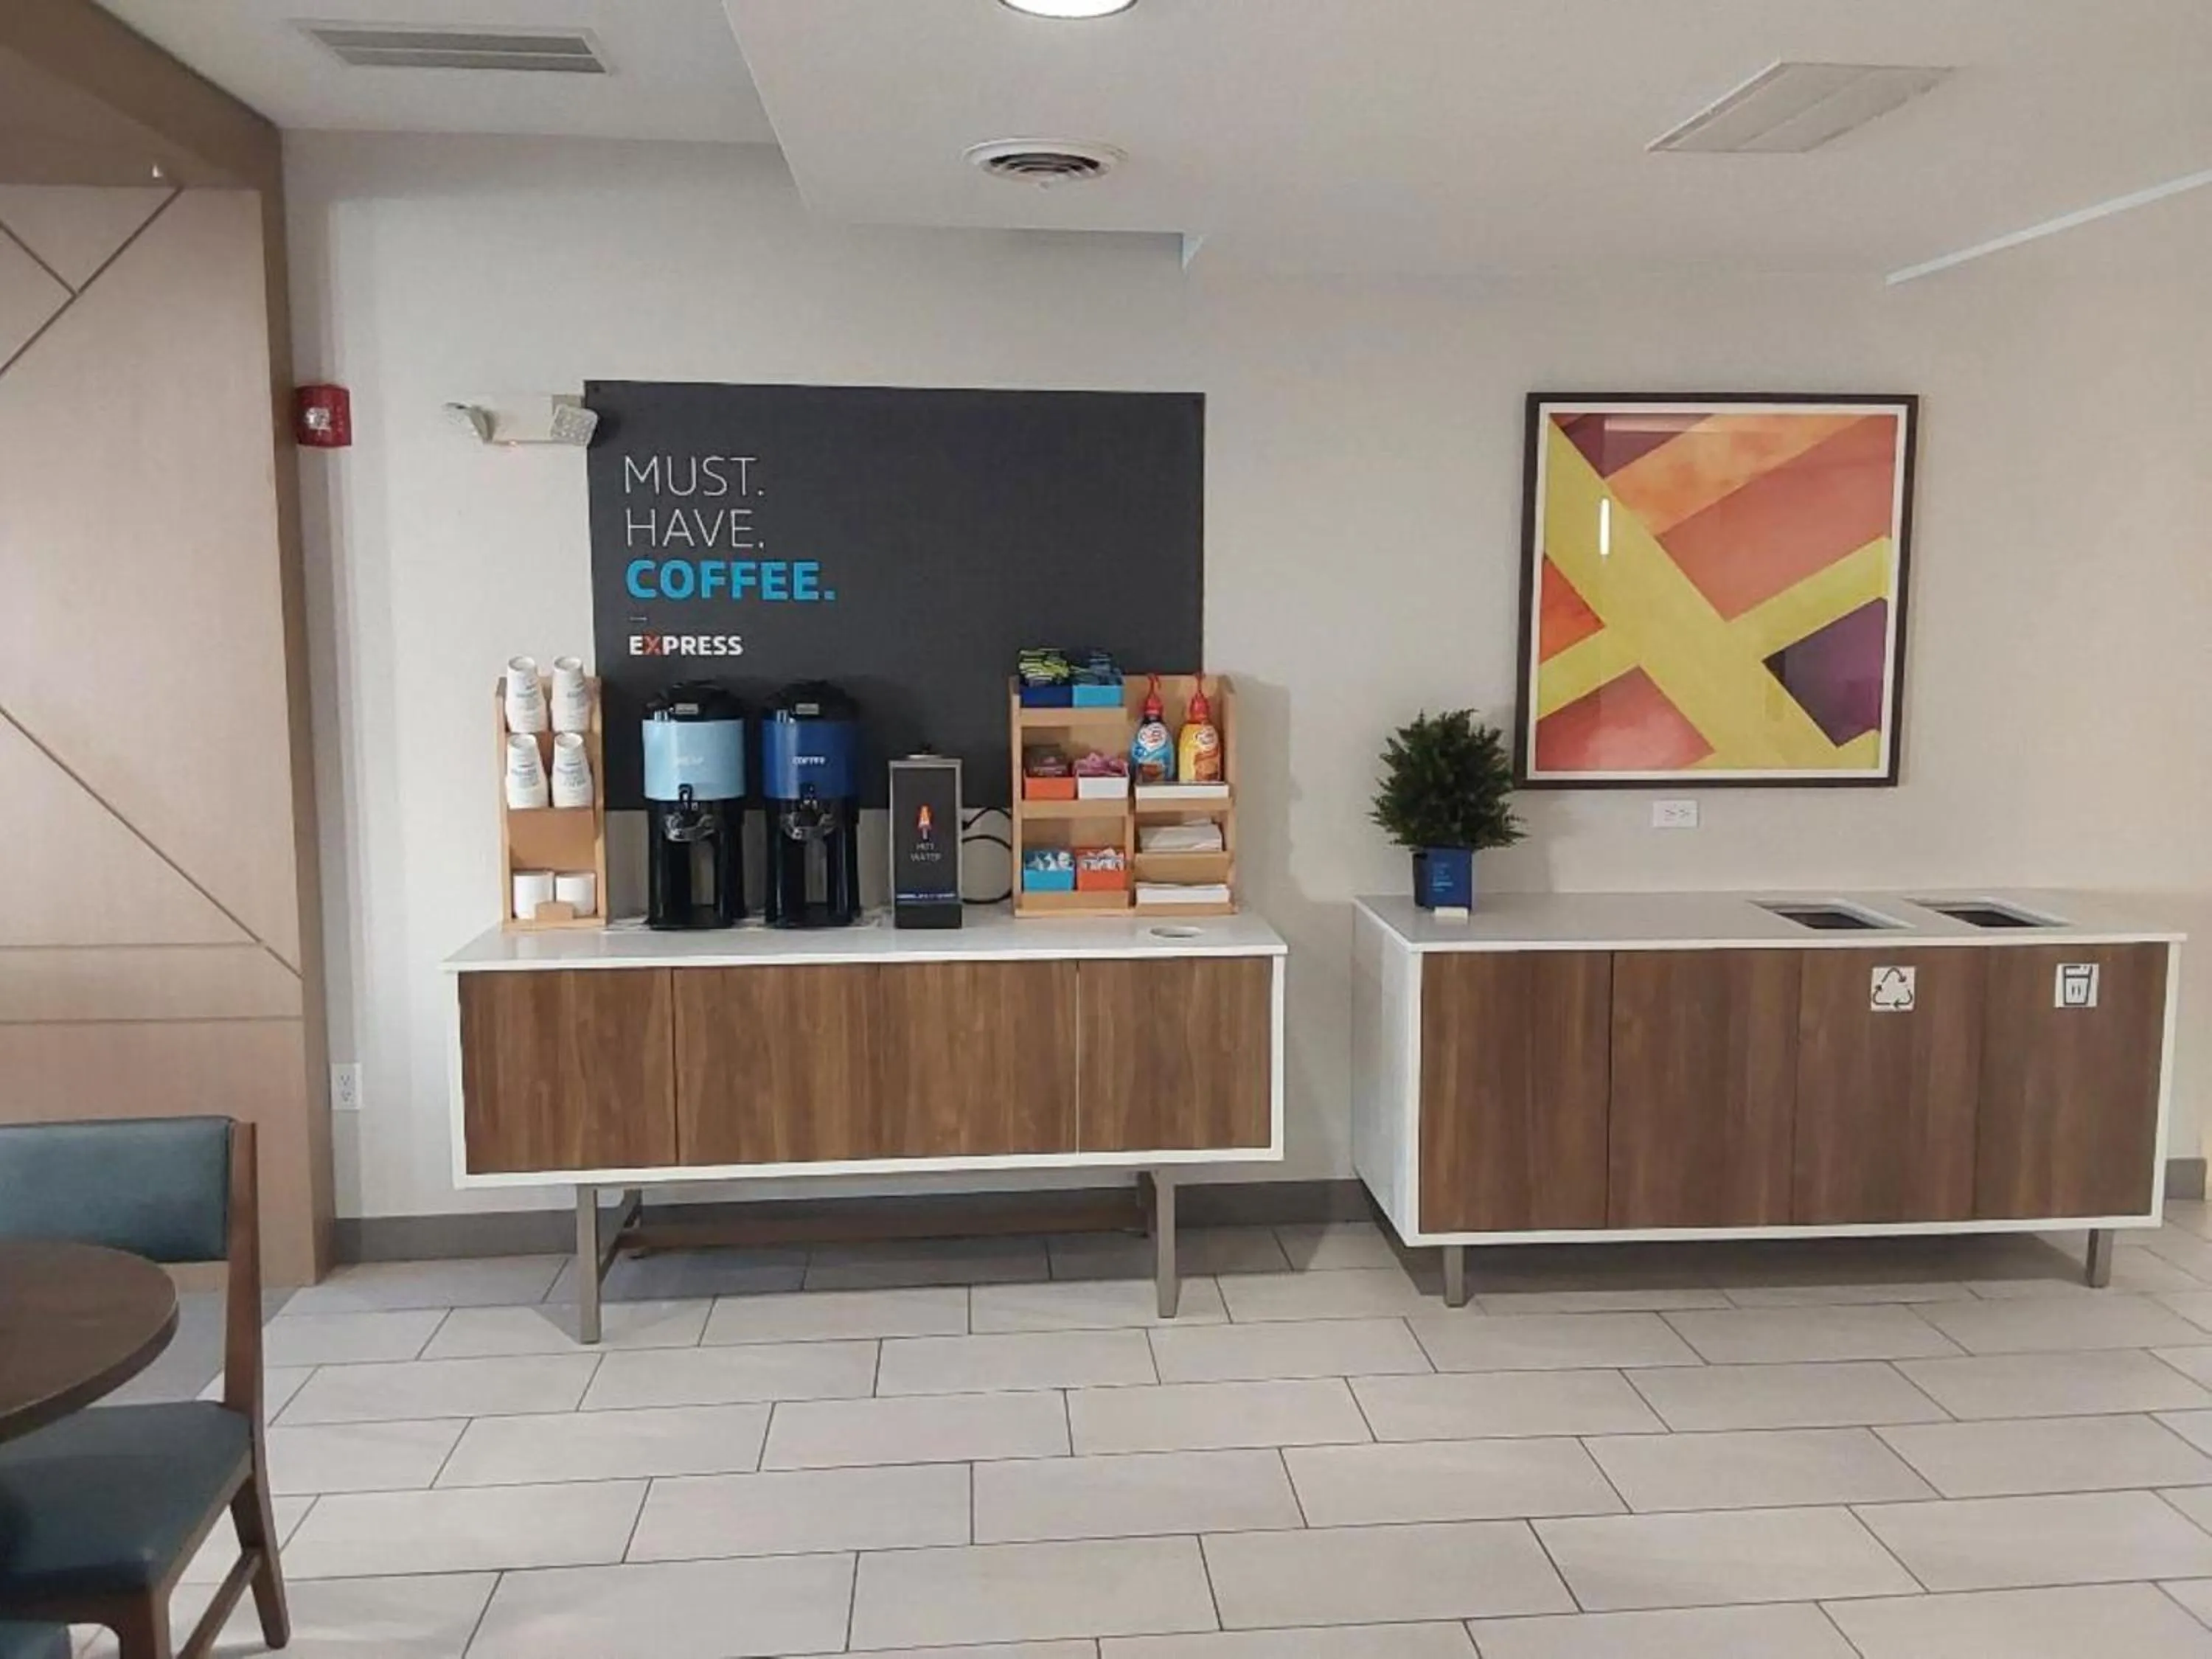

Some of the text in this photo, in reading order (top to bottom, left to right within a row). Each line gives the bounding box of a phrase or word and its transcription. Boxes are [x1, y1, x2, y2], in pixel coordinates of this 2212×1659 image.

[624, 455, 765, 496] MUST.
[626, 507, 765, 548] HAVE.
[626, 560, 836, 601] COFFEE.
[629, 634, 743, 655] EXPRESS
